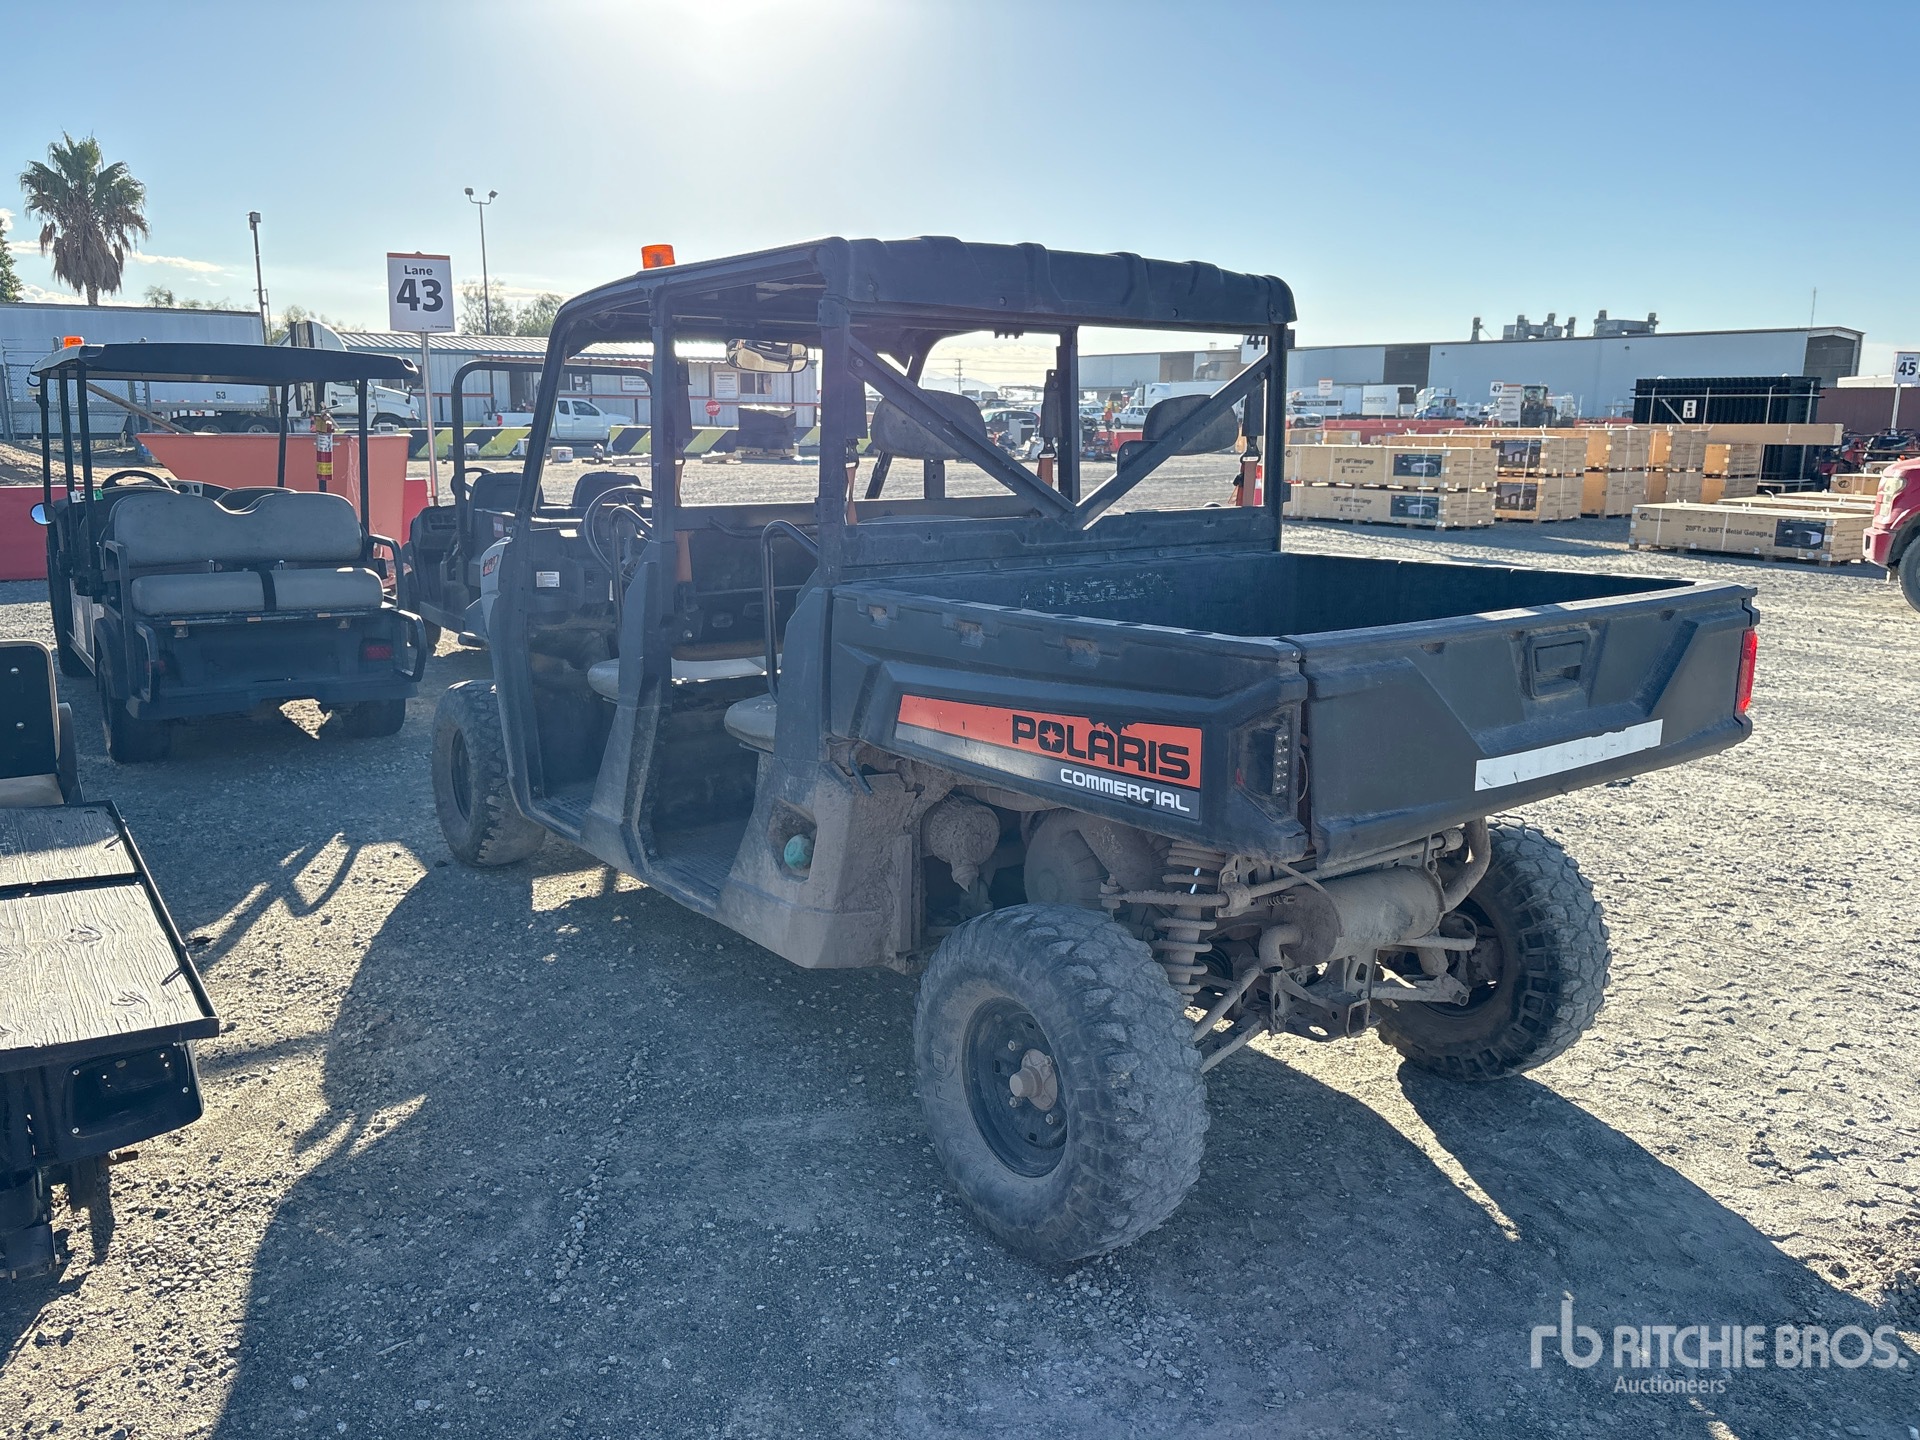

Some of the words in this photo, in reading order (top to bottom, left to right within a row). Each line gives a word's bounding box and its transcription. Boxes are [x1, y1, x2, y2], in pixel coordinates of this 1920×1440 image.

[404, 265, 433, 275] Lane
[397, 279, 443, 312] 43
[1898, 362, 1917, 376] 45
[216, 391, 226, 399] 53
[1492, 385, 1502, 393] 47
[706, 404, 720, 413] STOP
[1012, 714, 1191, 780] POLARIS
[1060, 768, 1190, 812] COMMERCIAL
